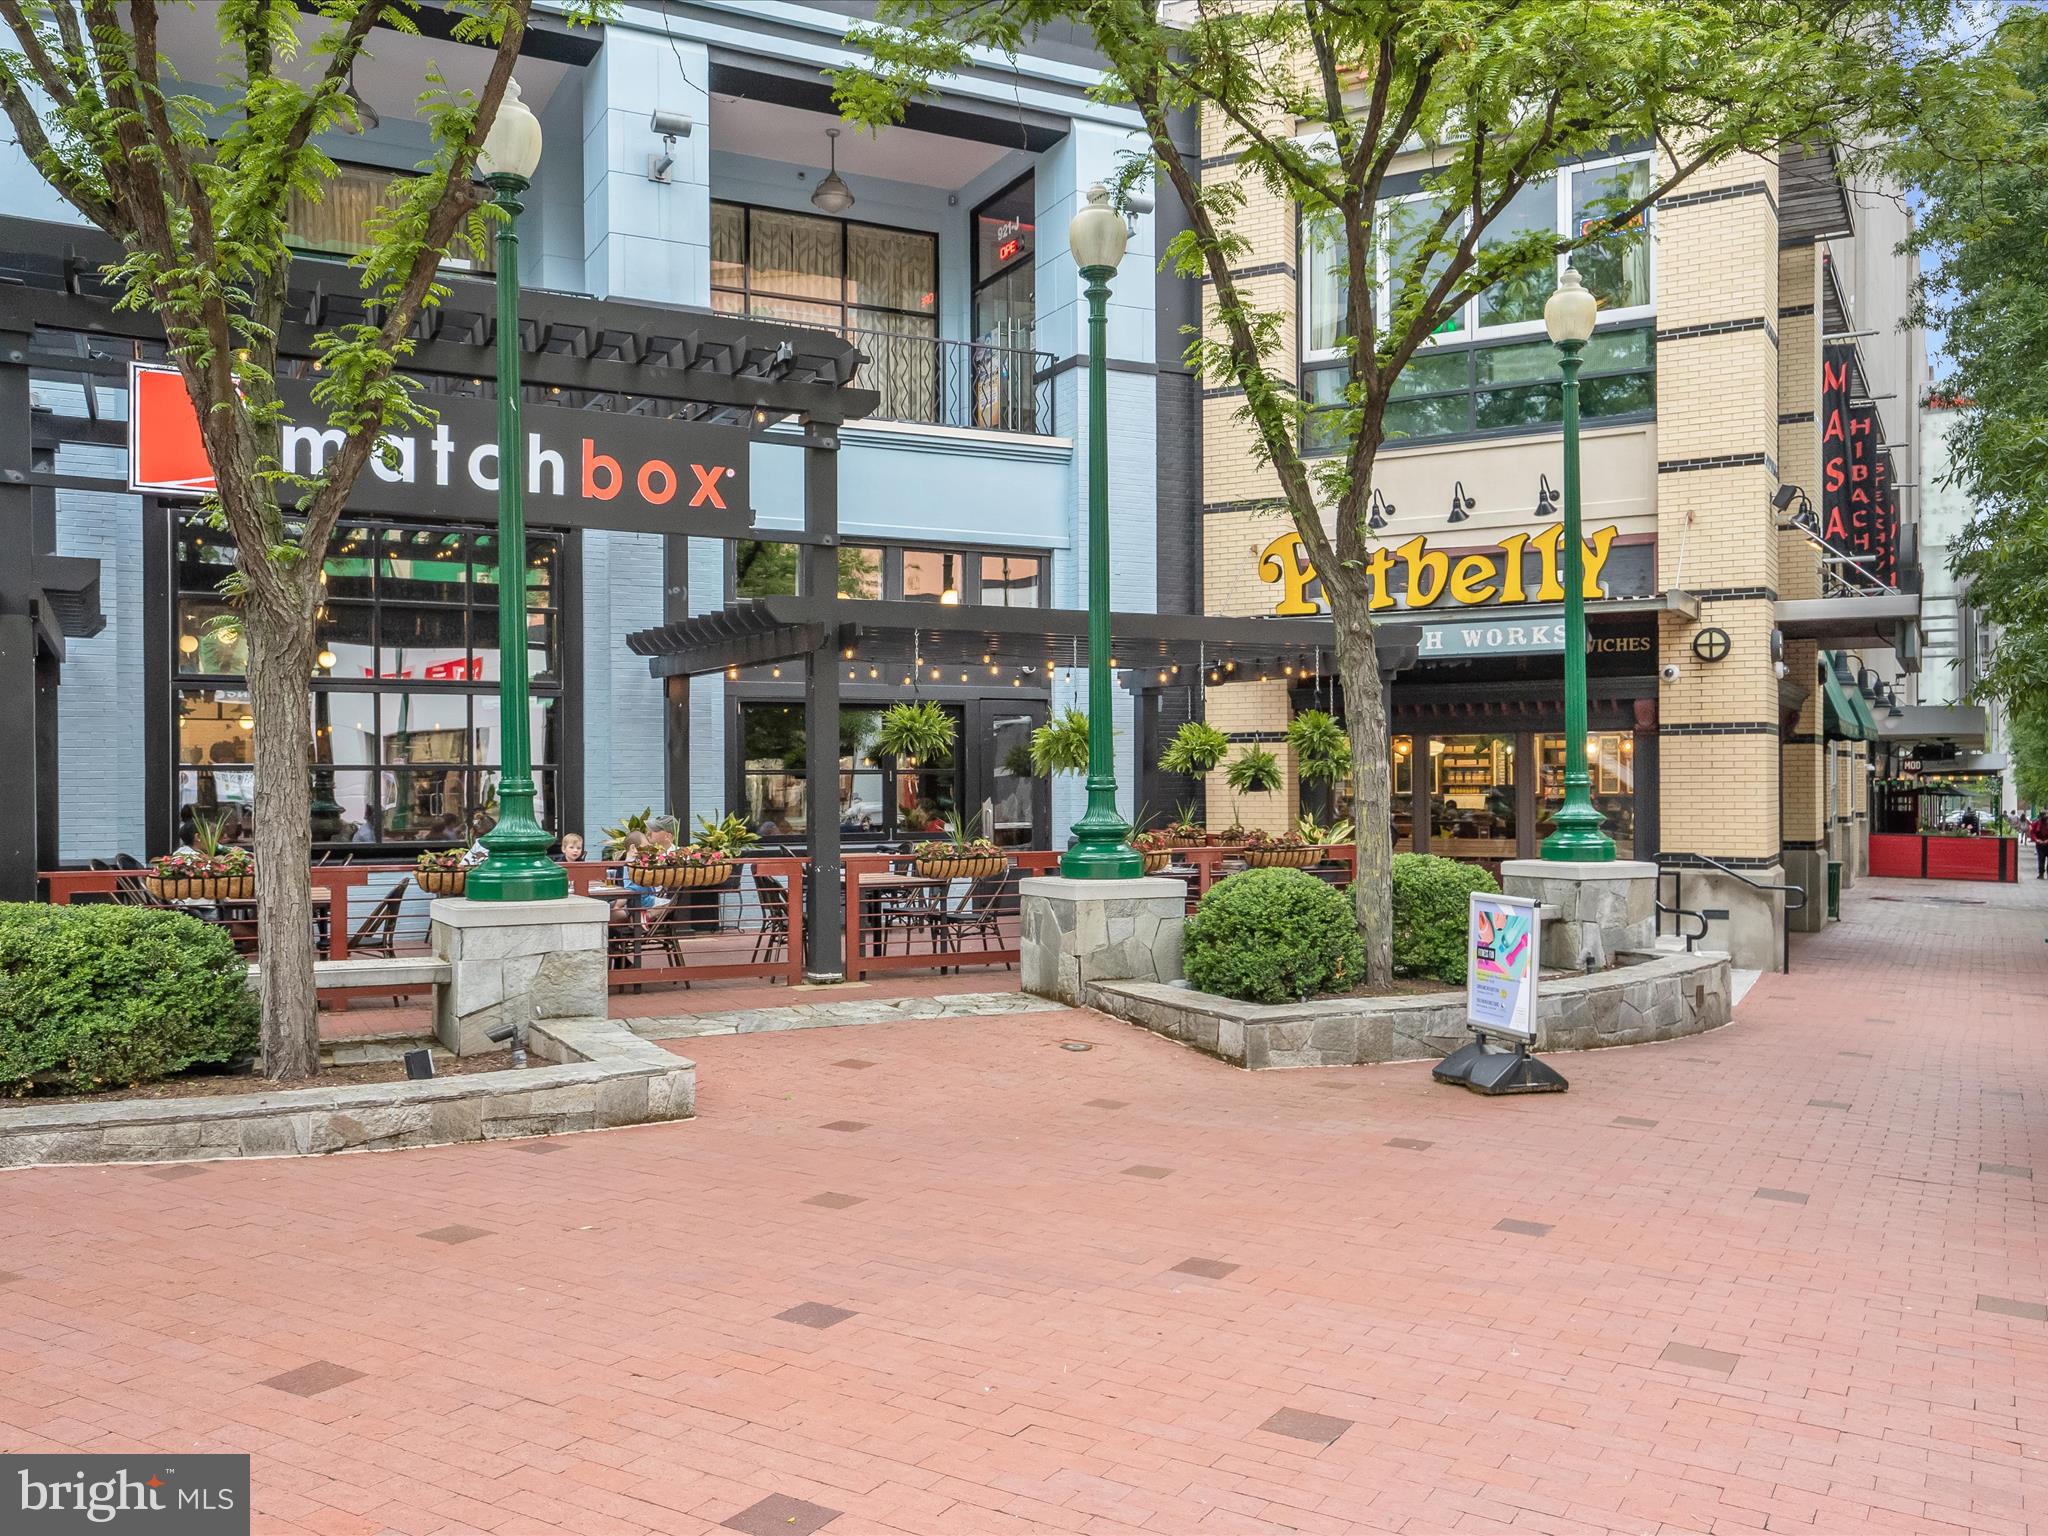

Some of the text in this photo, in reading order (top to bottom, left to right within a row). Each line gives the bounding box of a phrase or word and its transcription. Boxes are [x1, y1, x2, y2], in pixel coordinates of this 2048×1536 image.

[281, 423, 728, 510] matchbox
[1823, 361, 1848, 541] MASA
[1259, 522, 1618, 616] Ptbelly
